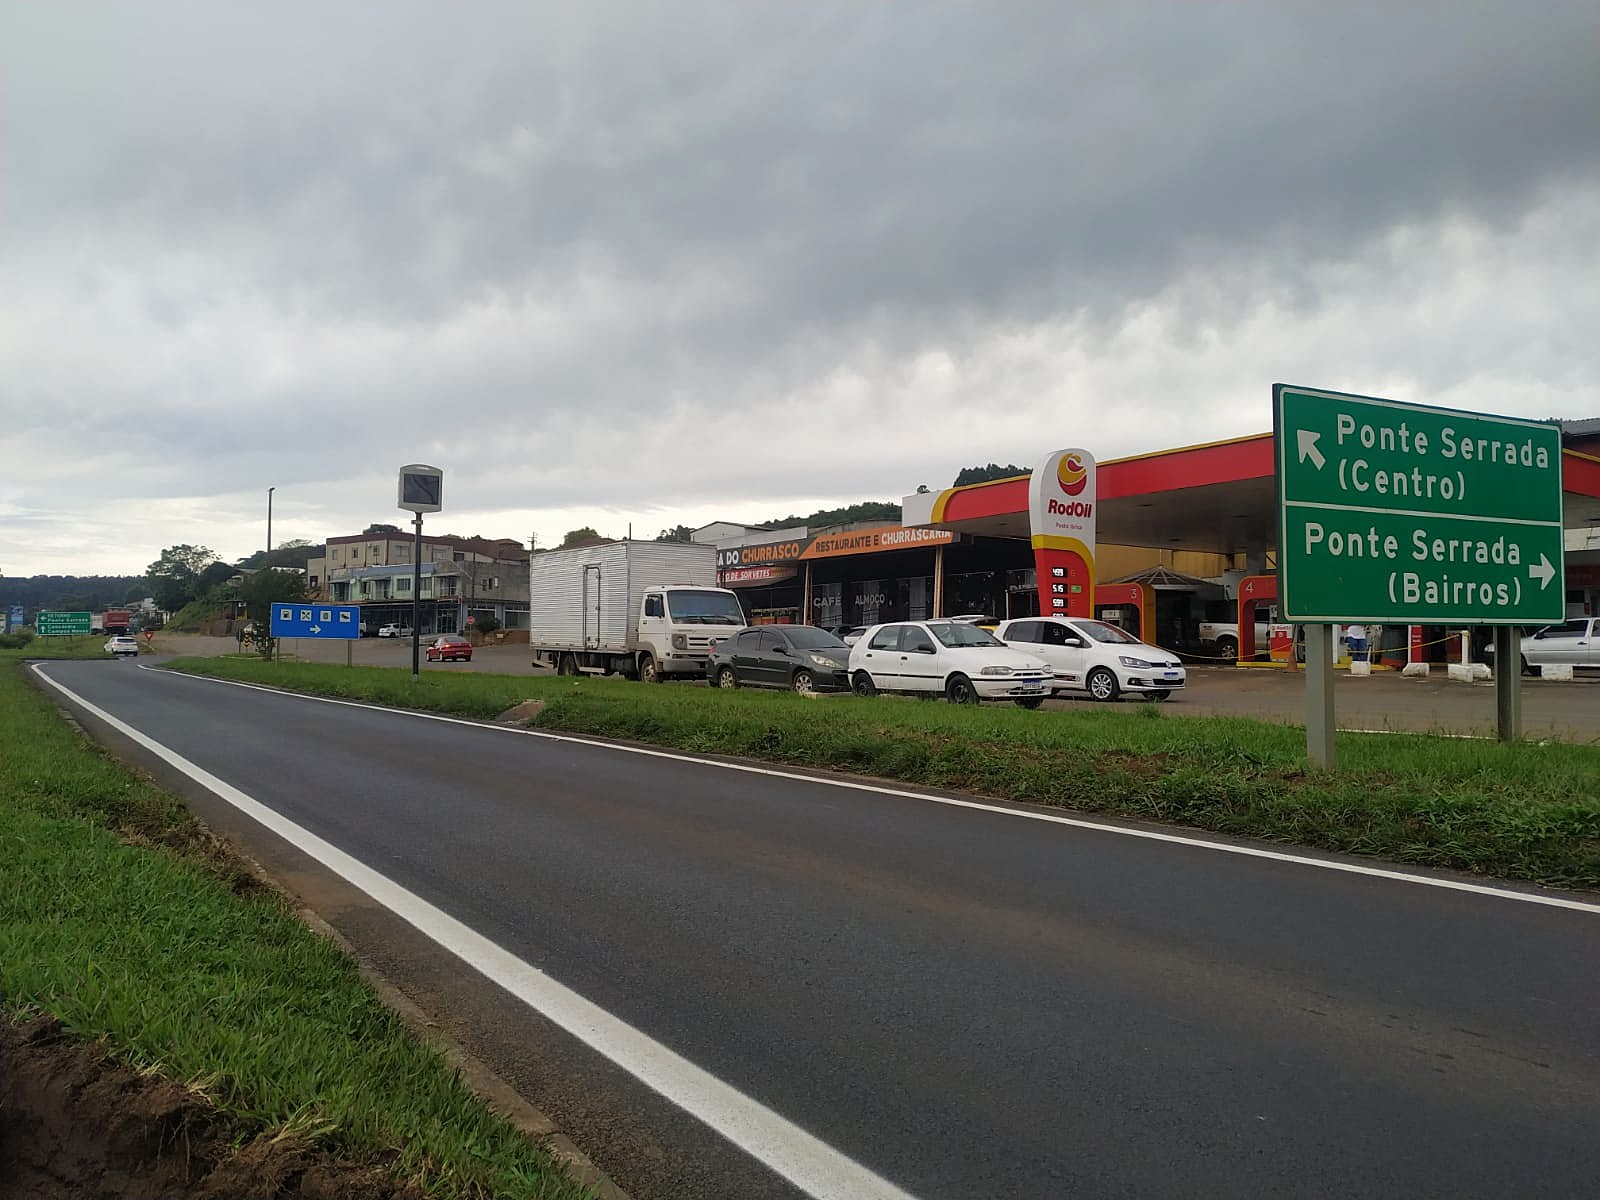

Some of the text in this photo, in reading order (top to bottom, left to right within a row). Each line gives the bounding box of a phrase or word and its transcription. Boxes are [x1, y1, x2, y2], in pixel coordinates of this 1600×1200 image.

[1337, 413, 1549, 468] Ponte Serrada
[1339, 459, 1465, 500] (Centro)
[1047, 498, 1093, 518] RodOil
[815, 528, 951, 553] RESTAURANTE E CHURRASCARIA
[1305, 522, 1521, 565] Ponte Serrada
[716, 542, 799, 566] A DO CHURRASCO
[1129, 588, 1137, 599] 3
[1246, 581, 1254, 593] 4
[1388, 573, 1521, 606] (Bairros)
[813, 592, 842, 607] CAFÉ
[855, 593, 886, 607] ALMOÇO
